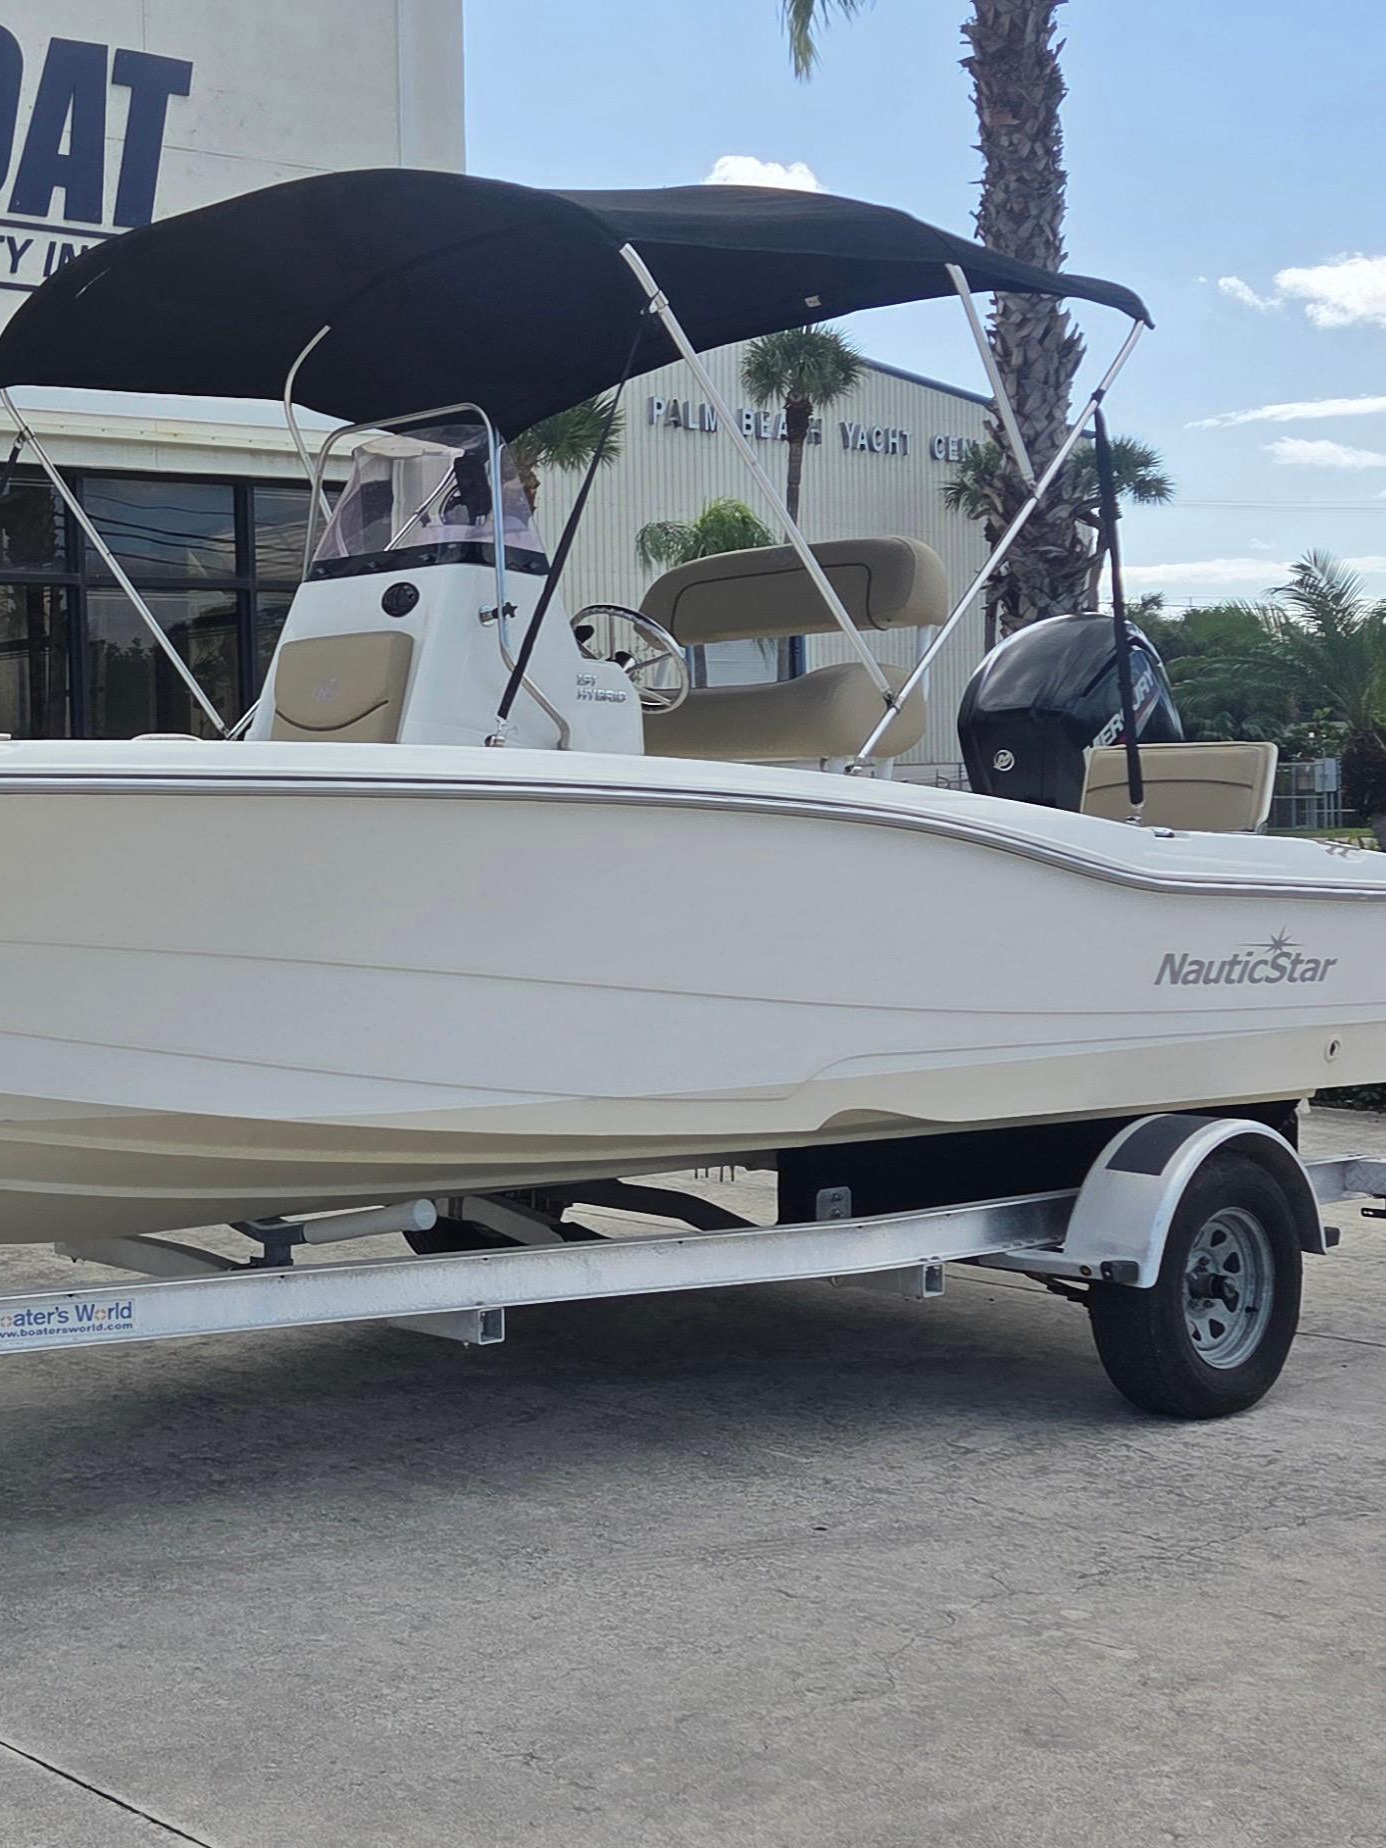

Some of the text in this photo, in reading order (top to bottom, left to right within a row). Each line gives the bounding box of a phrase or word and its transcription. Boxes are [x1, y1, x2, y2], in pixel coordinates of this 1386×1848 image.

[648, 395, 718, 433] PALM
[737, 407, 822, 445] BEAH
[839, 420, 911, 456] YACHT
[1154, 950, 1339, 986] NauticStar
[74, 1301, 133, 1322] World
